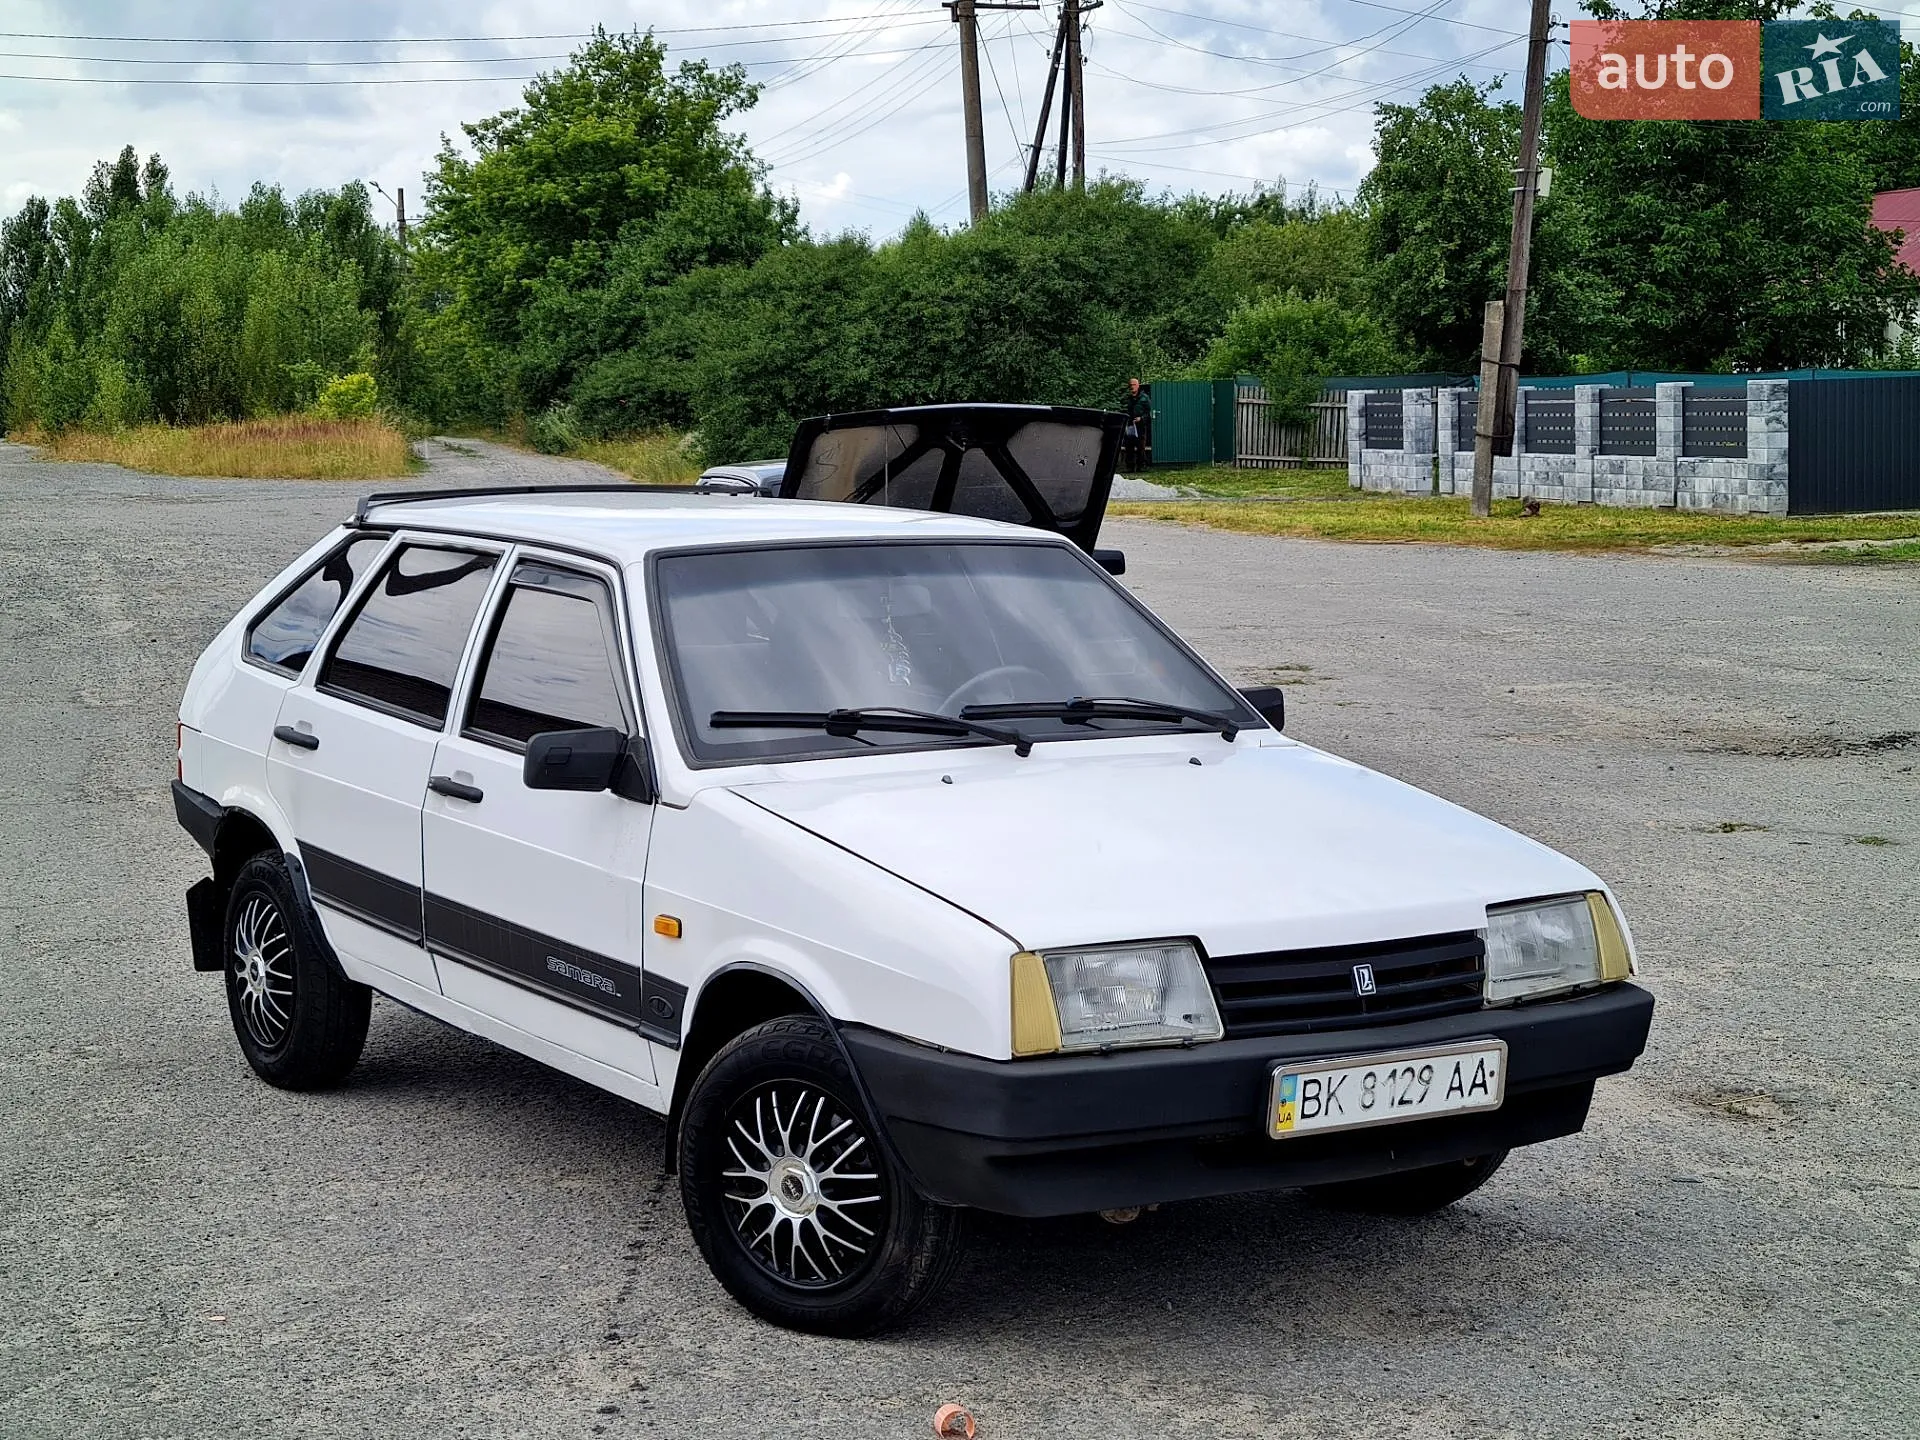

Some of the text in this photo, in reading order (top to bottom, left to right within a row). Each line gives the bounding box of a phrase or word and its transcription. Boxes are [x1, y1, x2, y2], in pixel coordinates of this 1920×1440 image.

[1300, 1057, 1489, 1119] BK 8129 AA
[1278, 1112, 1292, 1123] UA
